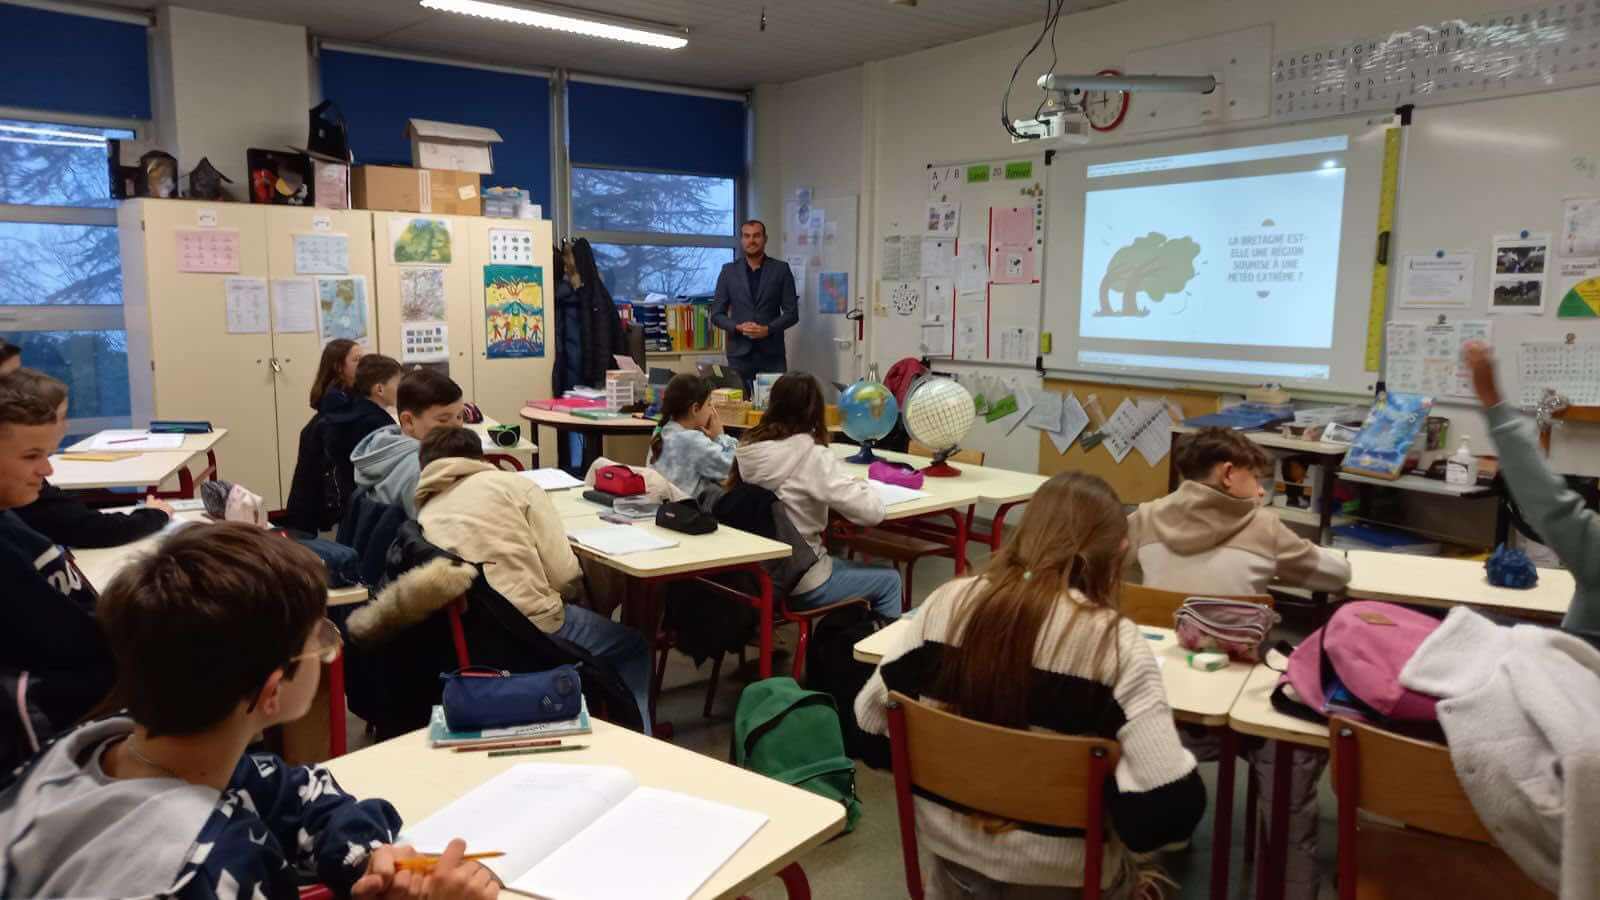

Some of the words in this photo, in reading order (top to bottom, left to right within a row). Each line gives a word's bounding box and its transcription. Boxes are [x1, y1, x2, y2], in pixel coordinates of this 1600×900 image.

[1228, 235, 1239, 246] LA
[1241, 234, 1285, 246] BRETAGNE
[1230, 248, 1250, 259] ELLE
[1251, 247, 1268, 258] UNE
[1233, 259, 1270, 271] SOUMISE
[1282, 258, 1298, 269] UNE
